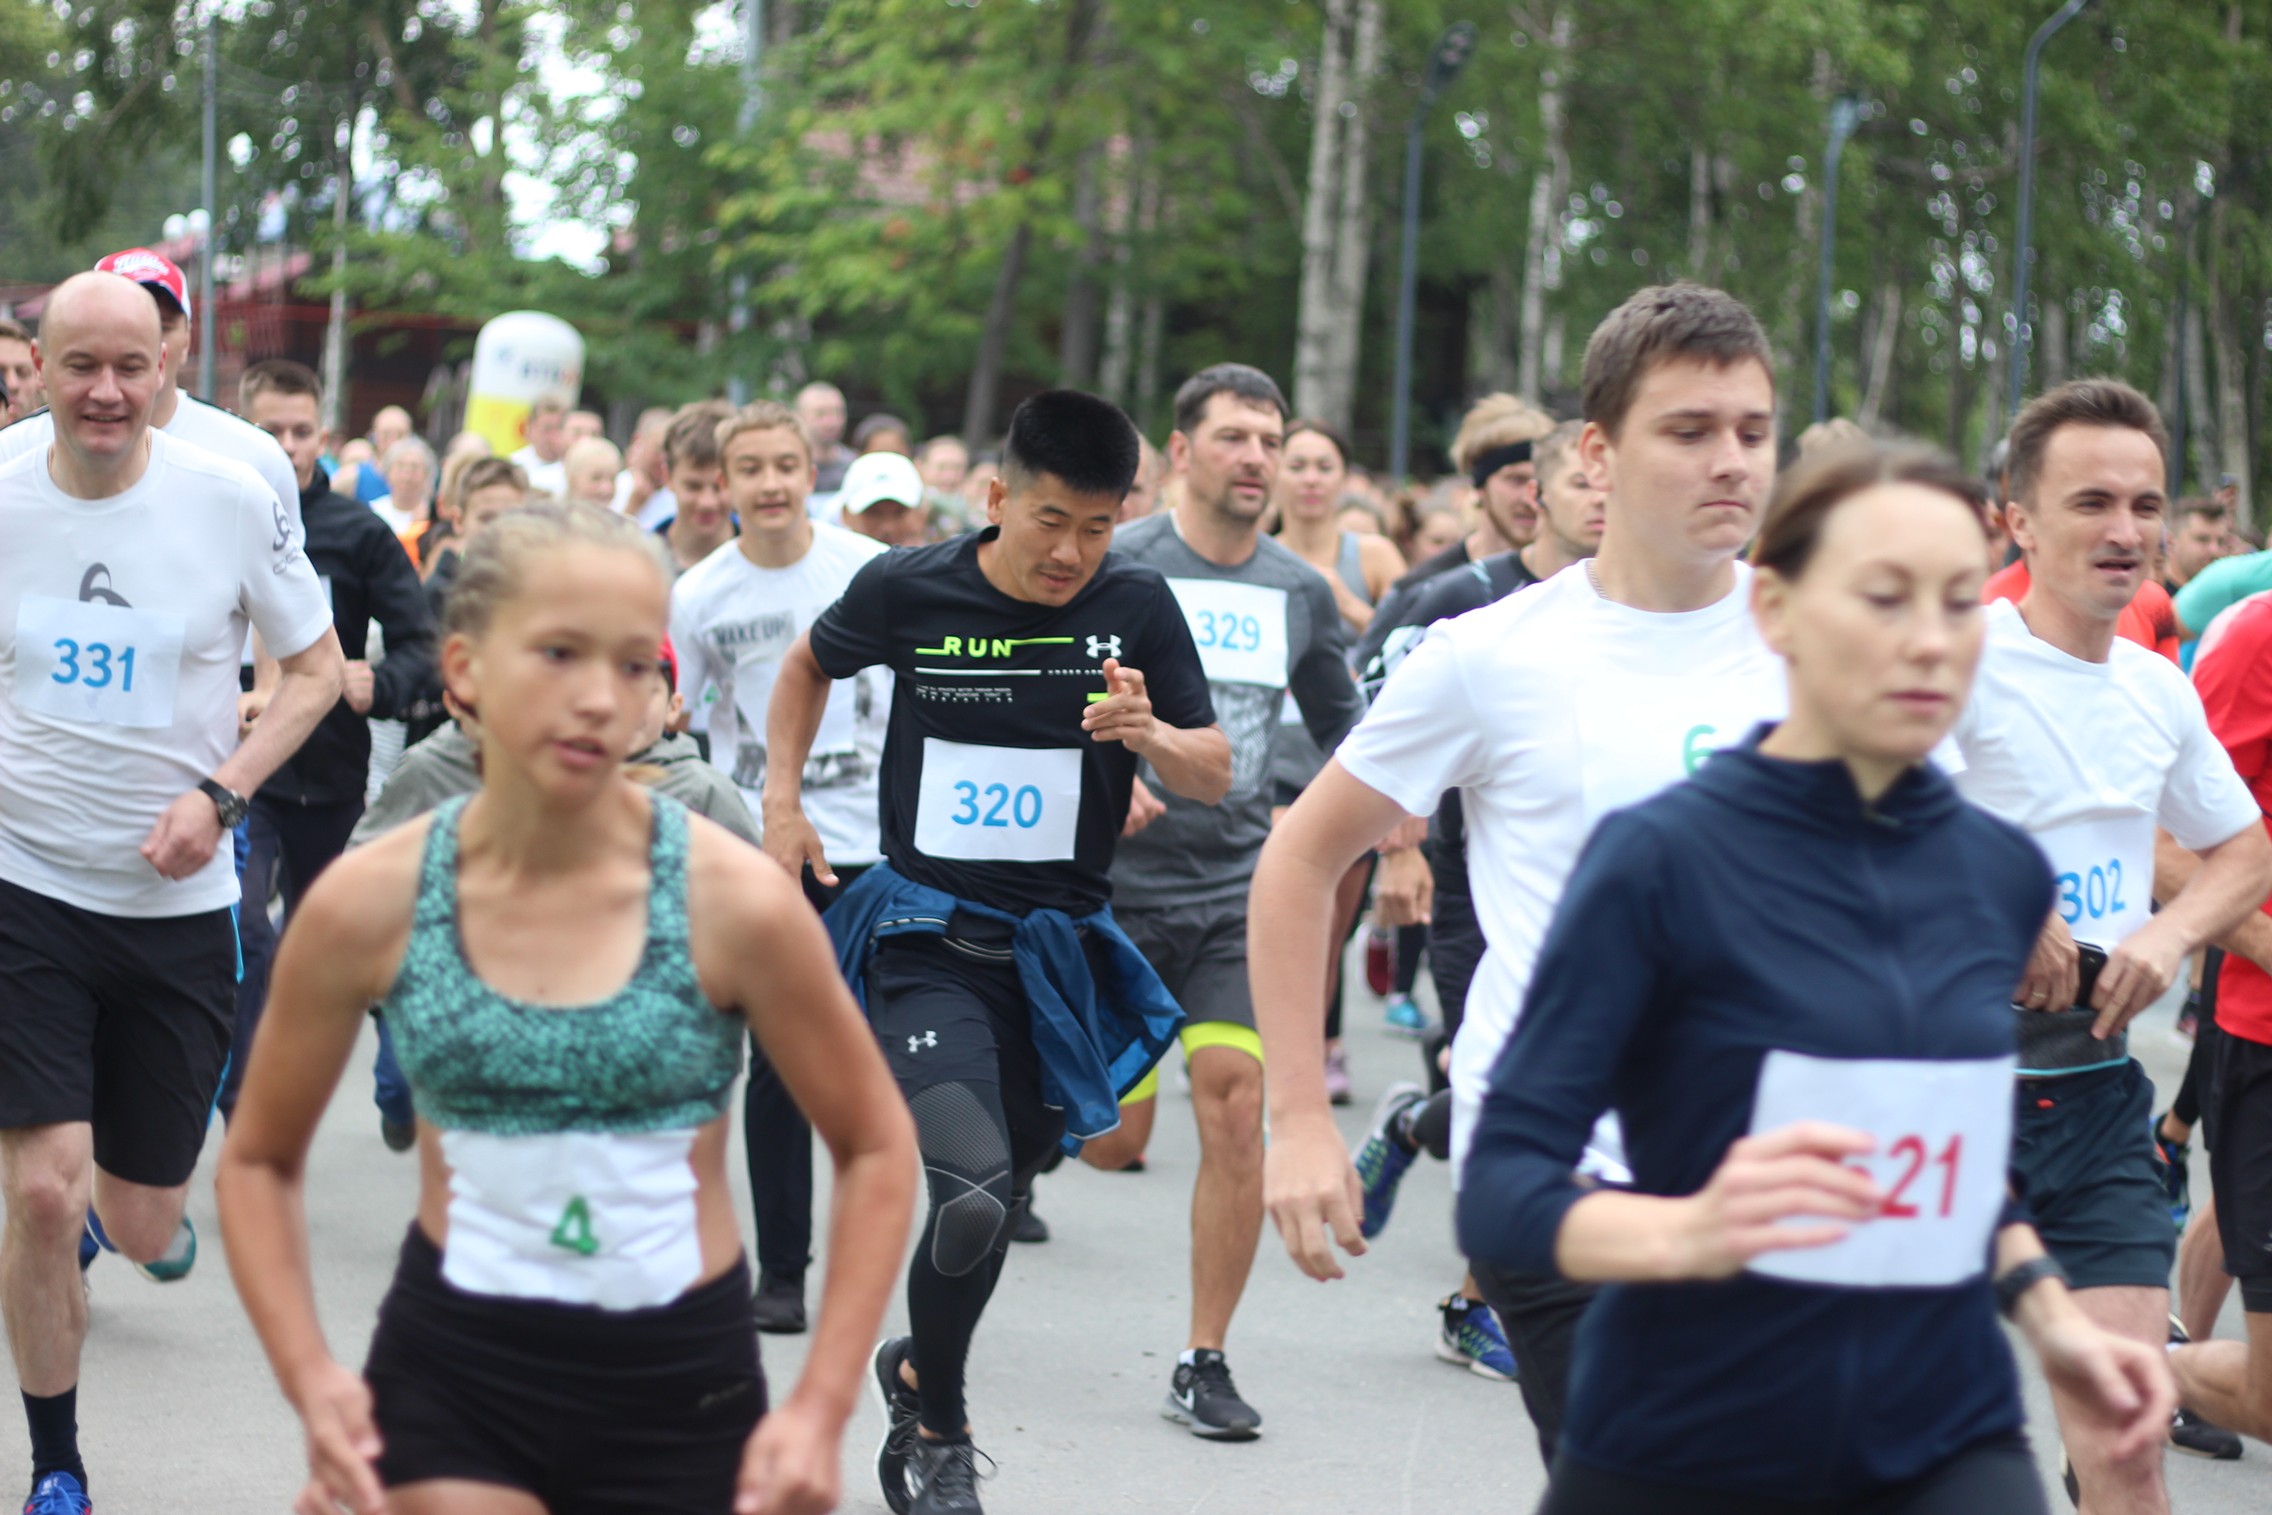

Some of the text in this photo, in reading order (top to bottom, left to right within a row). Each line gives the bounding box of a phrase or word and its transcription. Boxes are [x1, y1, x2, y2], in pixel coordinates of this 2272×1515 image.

[943, 635, 1012, 658] RUN
[1197, 610, 1261, 652] 329
[51, 637, 135, 692] 331
[1683, 724, 1718, 777] 6
[951, 780, 1043, 829] 320
[2055, 858, 2126, 925] 302
[1849, 1134, 1964, 1219] 21
